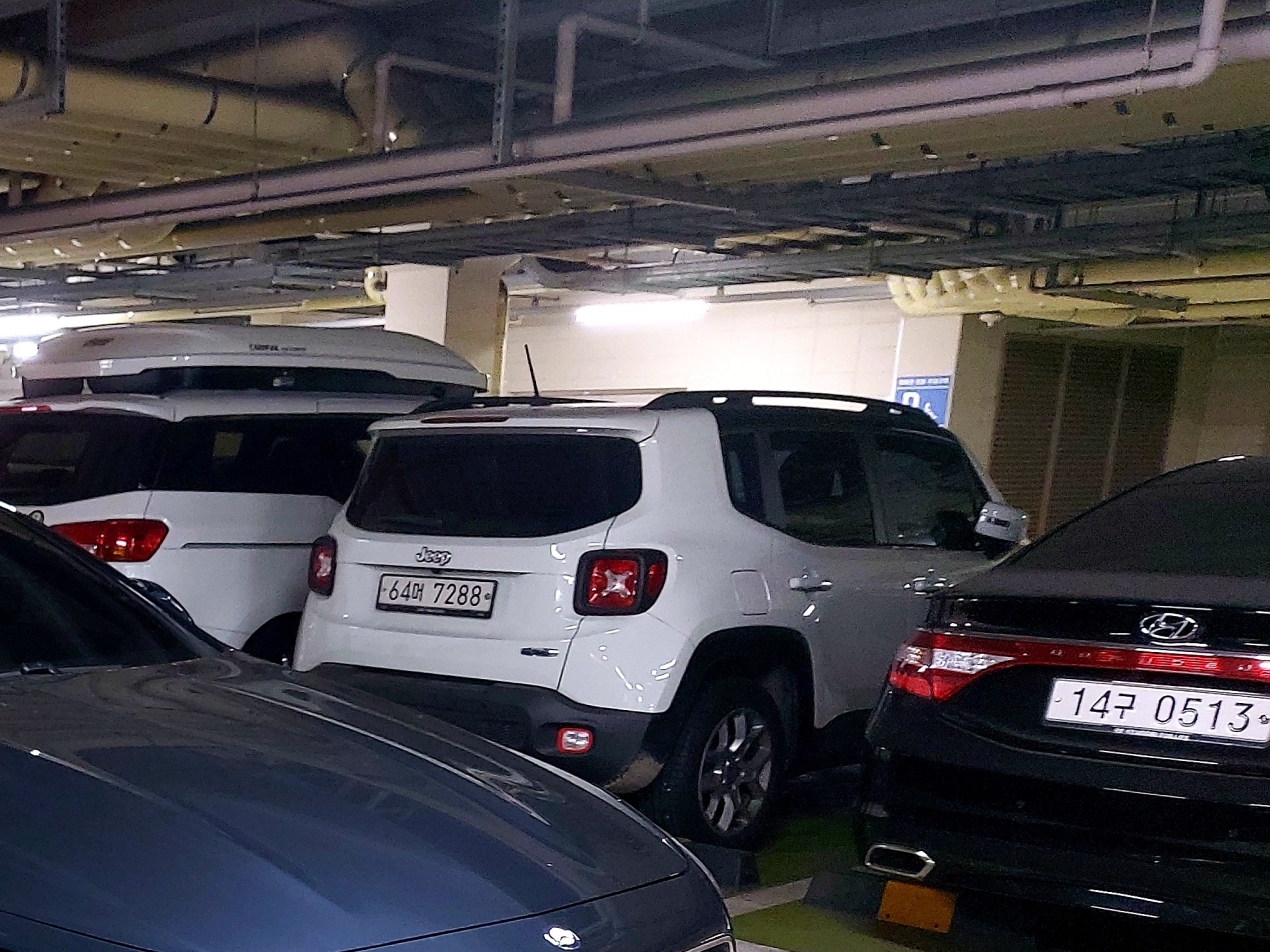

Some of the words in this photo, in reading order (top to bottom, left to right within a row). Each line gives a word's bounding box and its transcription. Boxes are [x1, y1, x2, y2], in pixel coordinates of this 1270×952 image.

[415, 546, 451, 566] Jeep
[433, 583, 482, 606] 7288
[1073, 687, 1136, 719] 14구
[1154, 694, 1254, 732] 0513
